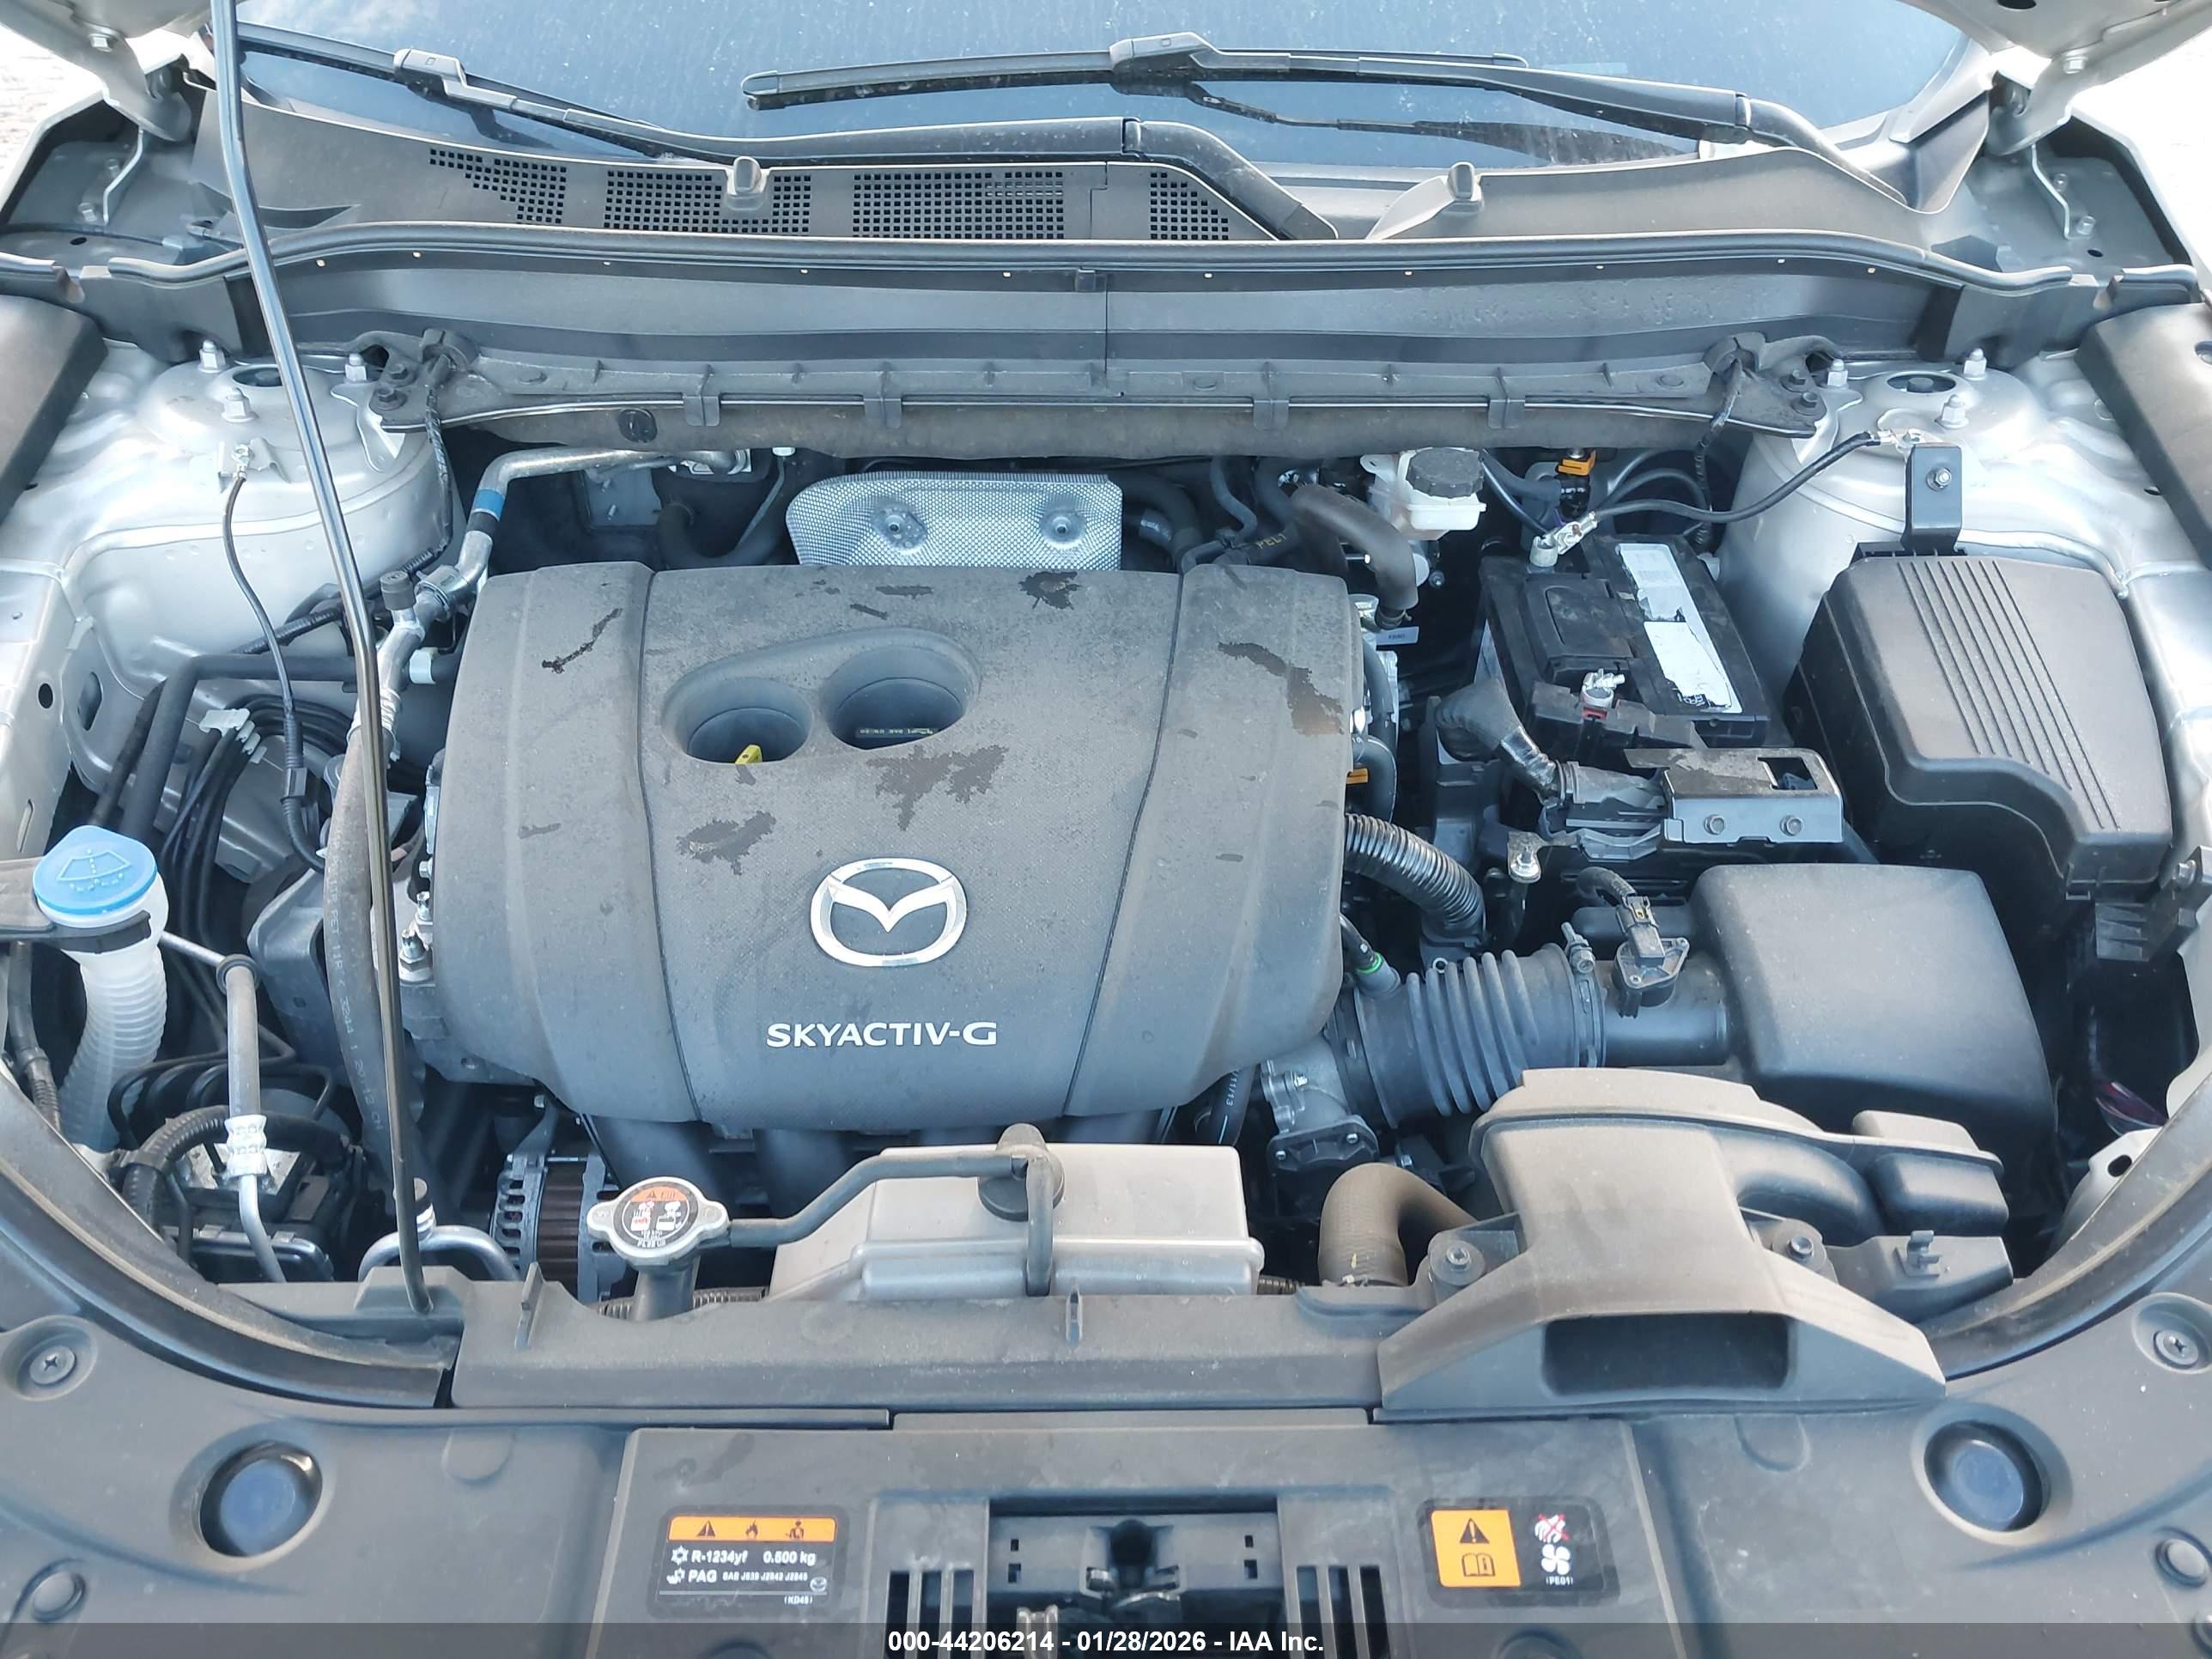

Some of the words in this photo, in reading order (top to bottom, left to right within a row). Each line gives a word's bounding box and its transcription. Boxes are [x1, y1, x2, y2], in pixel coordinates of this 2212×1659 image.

[765, 1021, 998, 1048] SKYACTIV-G
[690, 1549, 749, 1566] R-1234yf
[799, 1550, 817, 1567] kg
[688, 1570, 718, 1583] PAG
